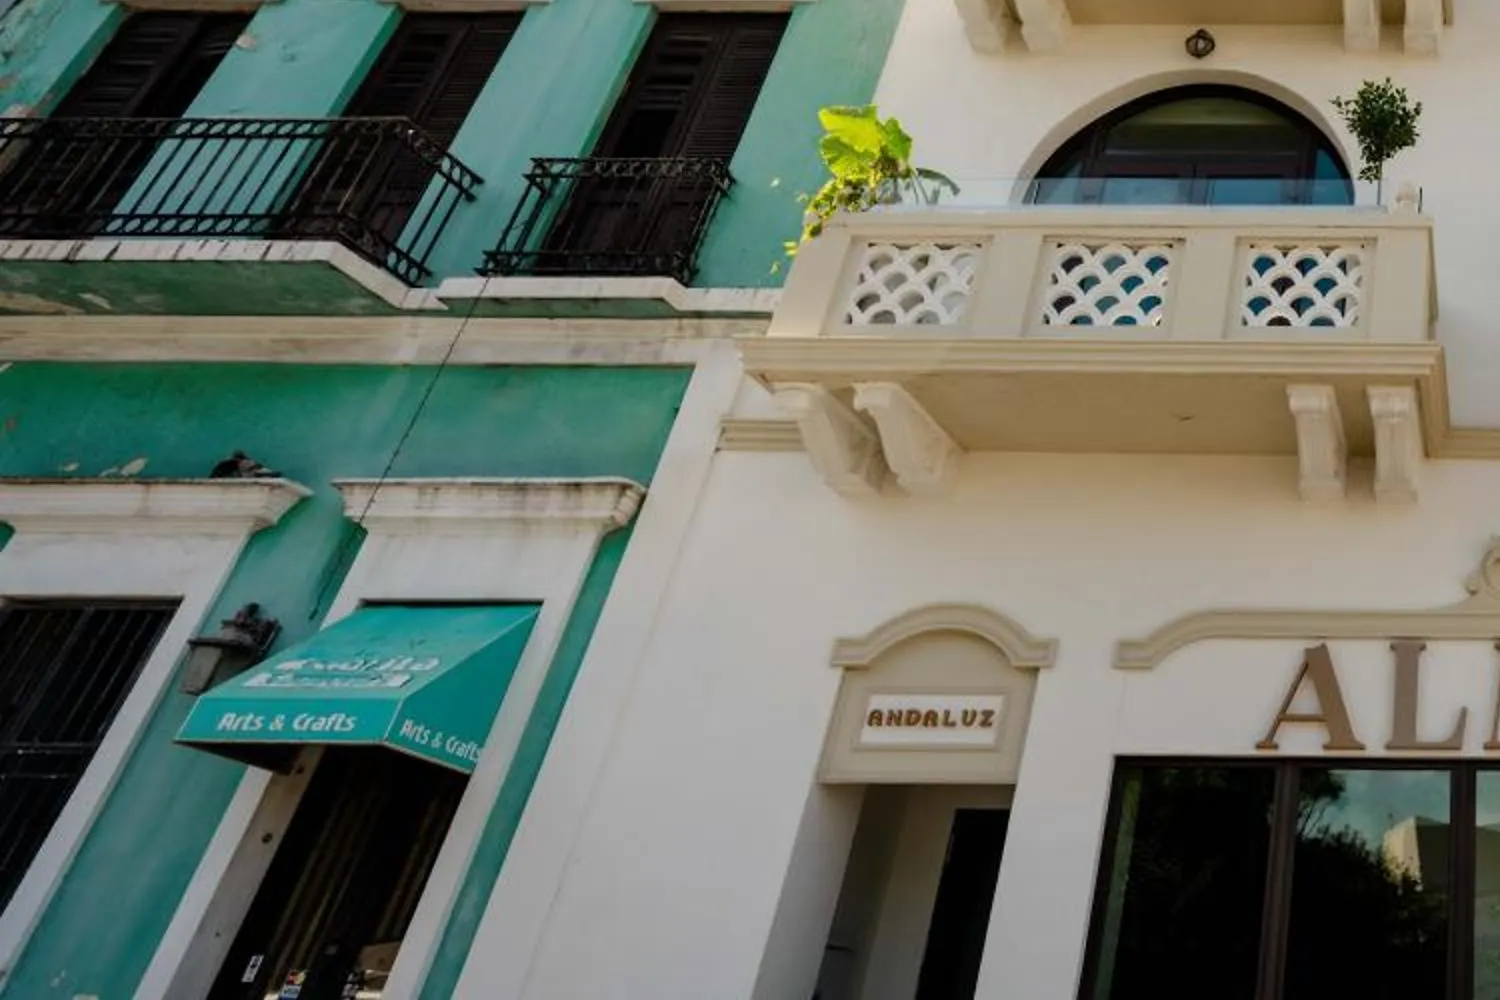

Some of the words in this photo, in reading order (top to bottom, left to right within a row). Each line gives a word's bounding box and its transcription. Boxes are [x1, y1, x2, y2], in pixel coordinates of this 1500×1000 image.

[216, 712, 263, 732] Arts
[269, 714, 285, 730] &
[291, 711, 357, 732] Crafts
[867, 708, 995, 728] ANDALUZ
[399, 718, 431, 746] Arts
[431, 731, 443, 749] &
